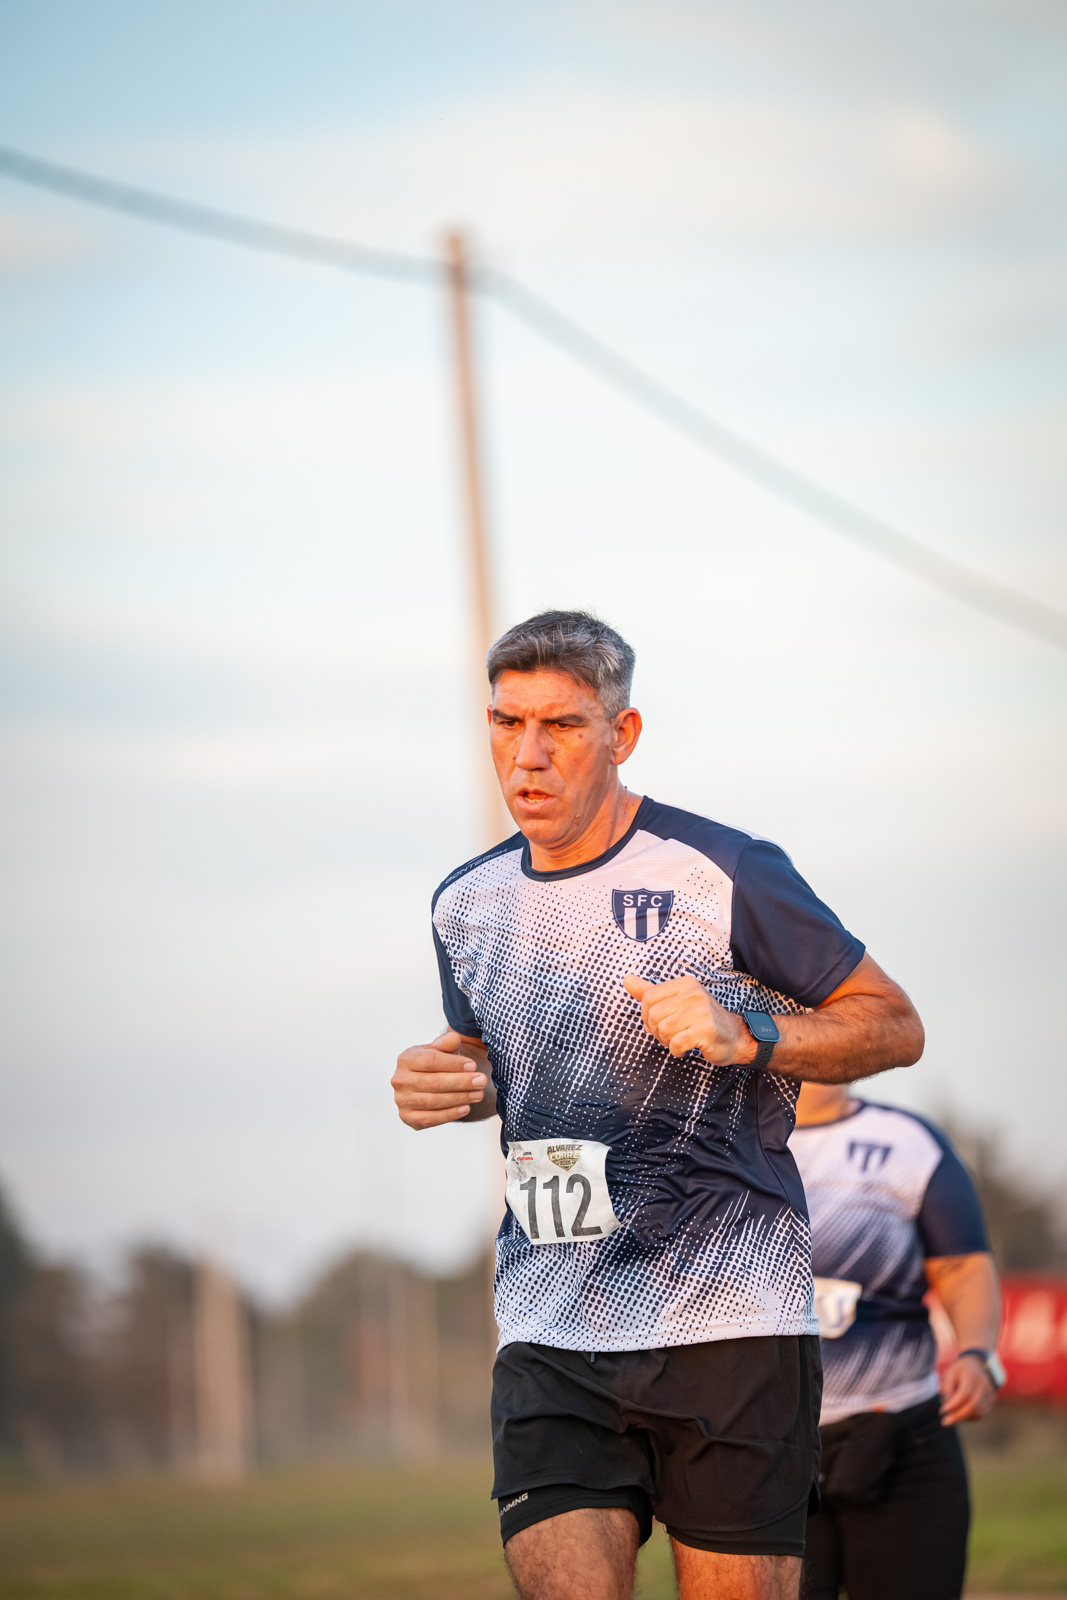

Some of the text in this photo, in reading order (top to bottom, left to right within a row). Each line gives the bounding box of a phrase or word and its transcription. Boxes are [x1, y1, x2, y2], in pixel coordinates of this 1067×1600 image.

[622, 894, 663, 907] SFC
[547, 1144, 583, 1155] ALVAREZ
[550, 1151, 581, 1161] CORRE
[520, 1174, 602, 1239] 112
